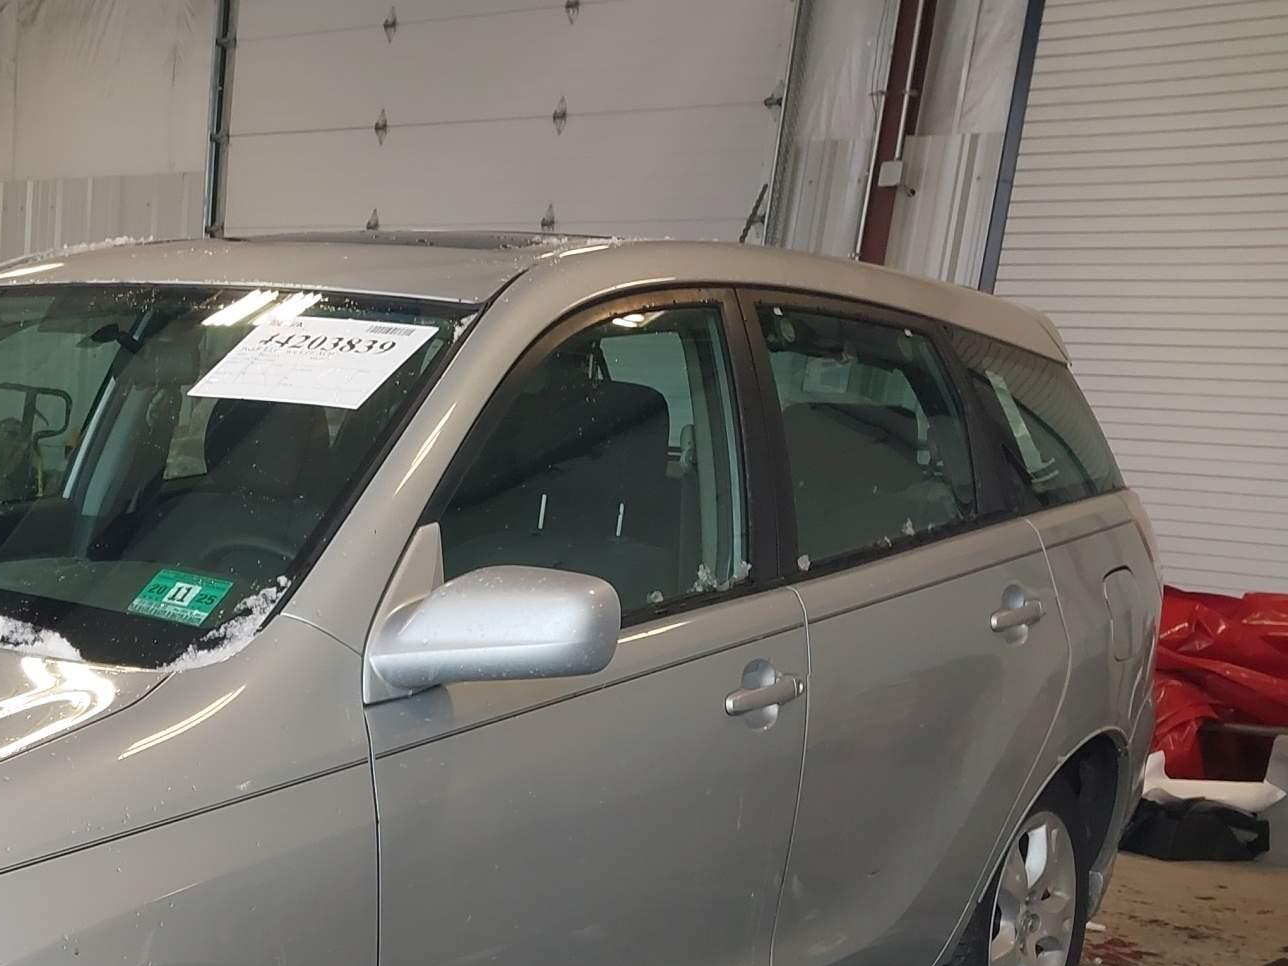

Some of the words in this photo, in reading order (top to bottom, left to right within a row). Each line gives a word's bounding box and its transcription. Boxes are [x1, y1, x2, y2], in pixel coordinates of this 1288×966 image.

[259, 332, 397, 355] 44203839
[147, 583, 167, 595] 20
[167, 586, 192, 603] 11
[195, 593, 217, 605] 25
